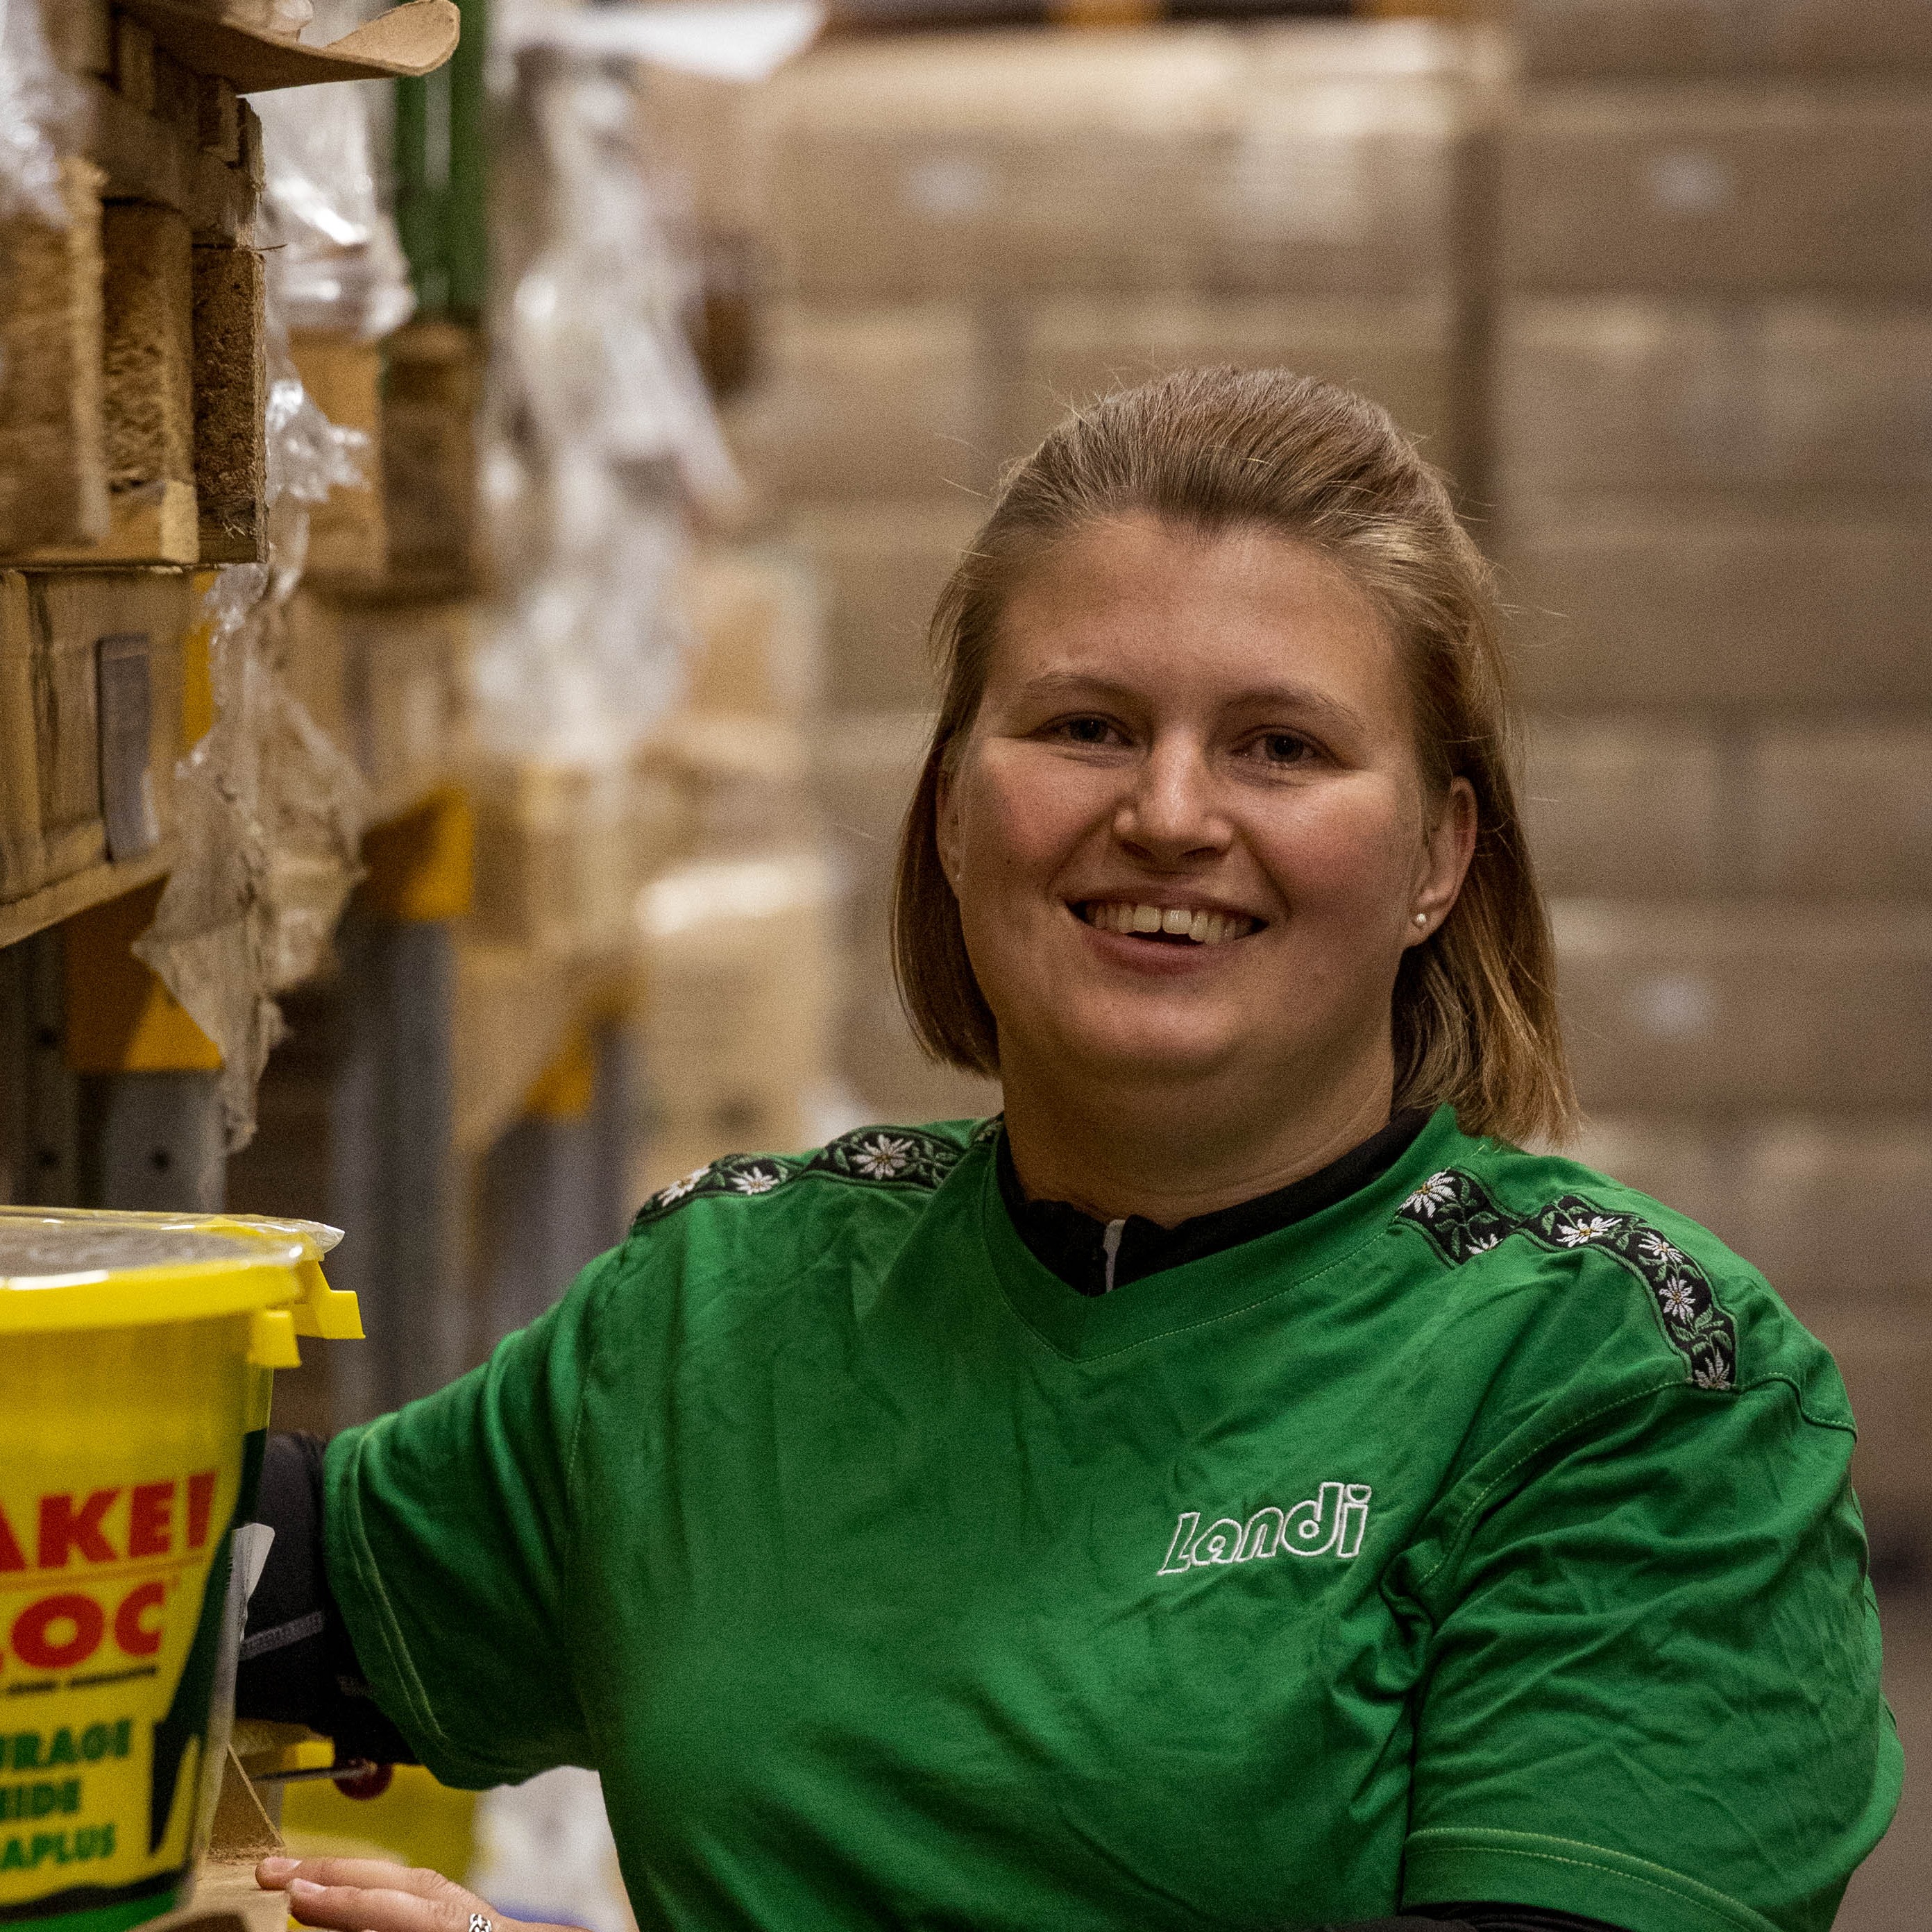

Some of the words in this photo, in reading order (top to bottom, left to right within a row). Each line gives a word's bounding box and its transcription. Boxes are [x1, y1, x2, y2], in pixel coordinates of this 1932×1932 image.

[1157, 1482, 1372, 1577] Landi
[0, 1582, 165, 1671] OC
[0, 1718, 132, 1770] RAGE
